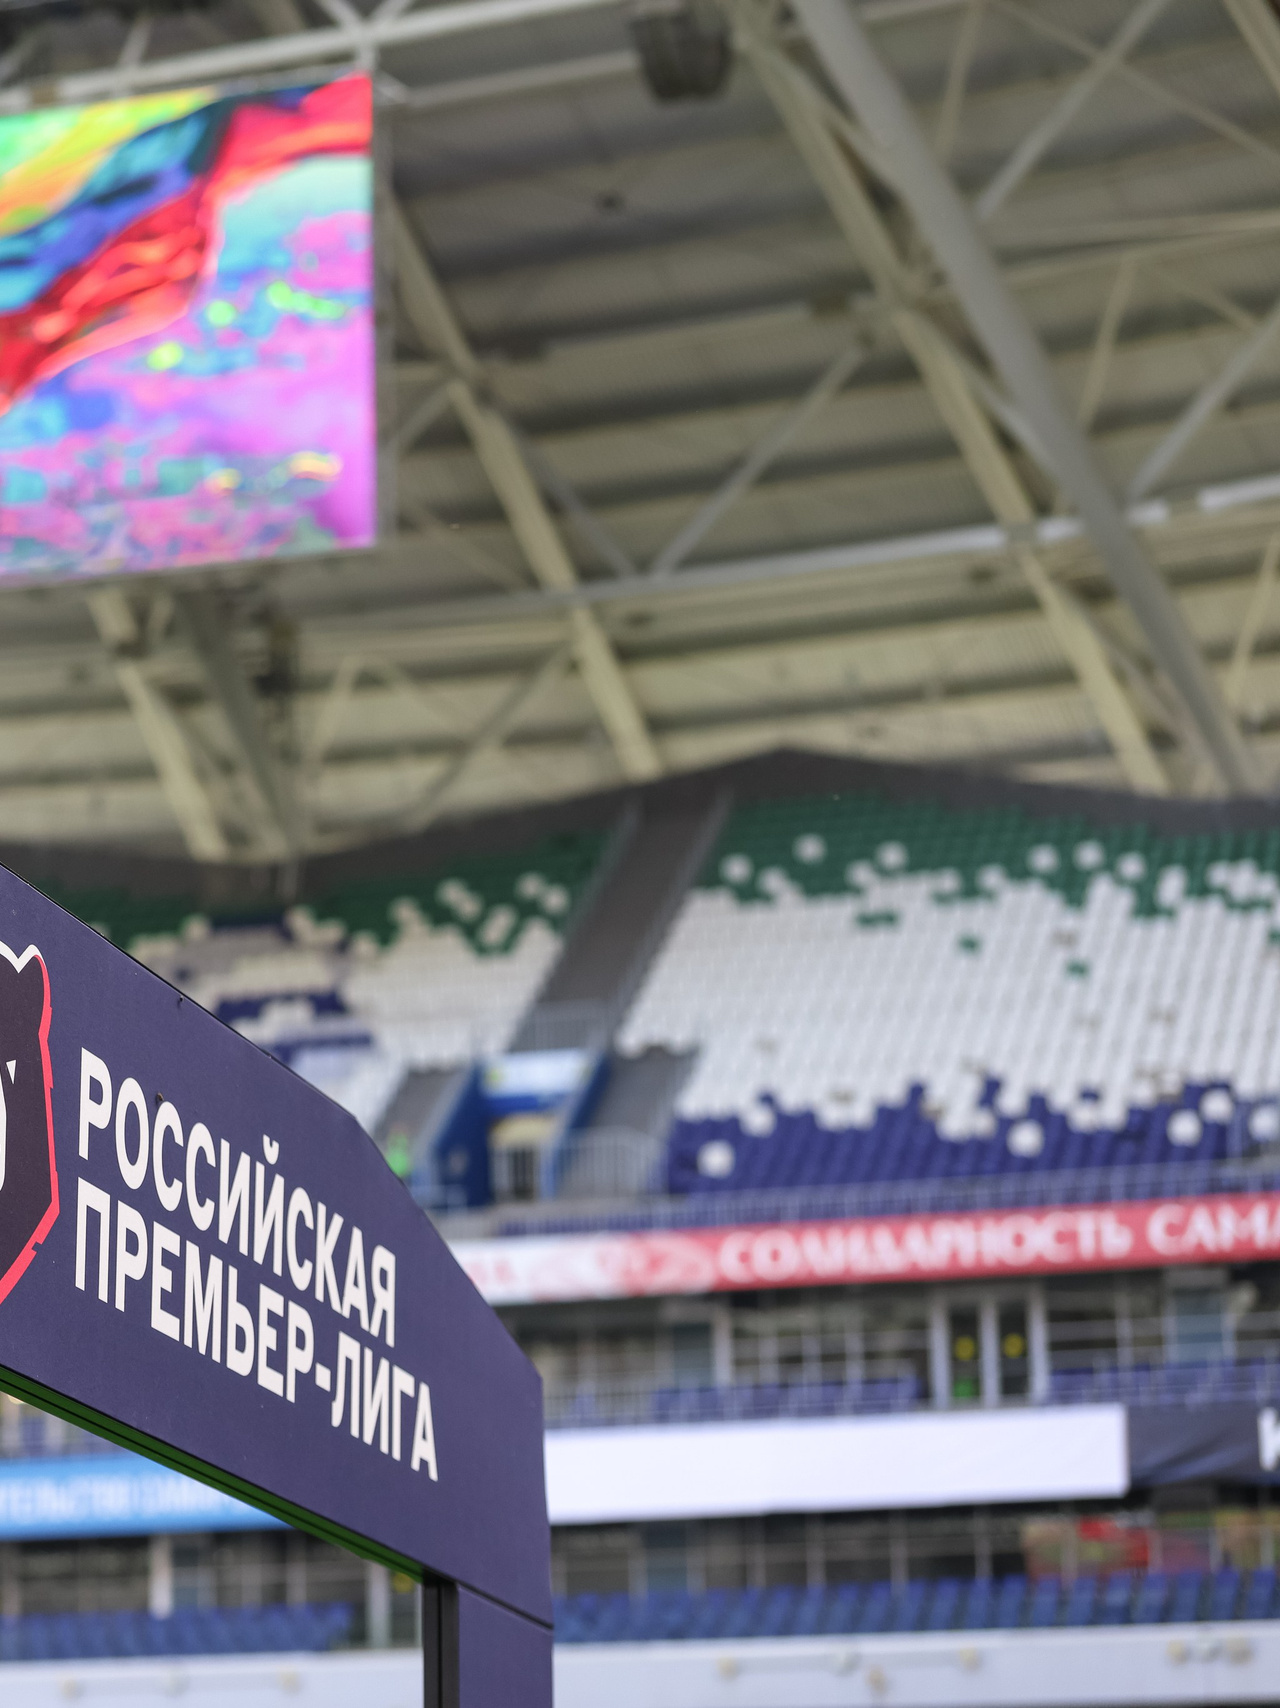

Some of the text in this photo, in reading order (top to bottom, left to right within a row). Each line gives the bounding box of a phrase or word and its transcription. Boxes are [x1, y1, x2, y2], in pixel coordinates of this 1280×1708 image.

[75, 1176, 438, 1482] ПРЕМЬЕР-ЛИГА
[78, 1046, 396, 1348] РОССИЙСКАЯ
[721, 1210, 1133, 1284] СОЛИДАРНОСТЬ
